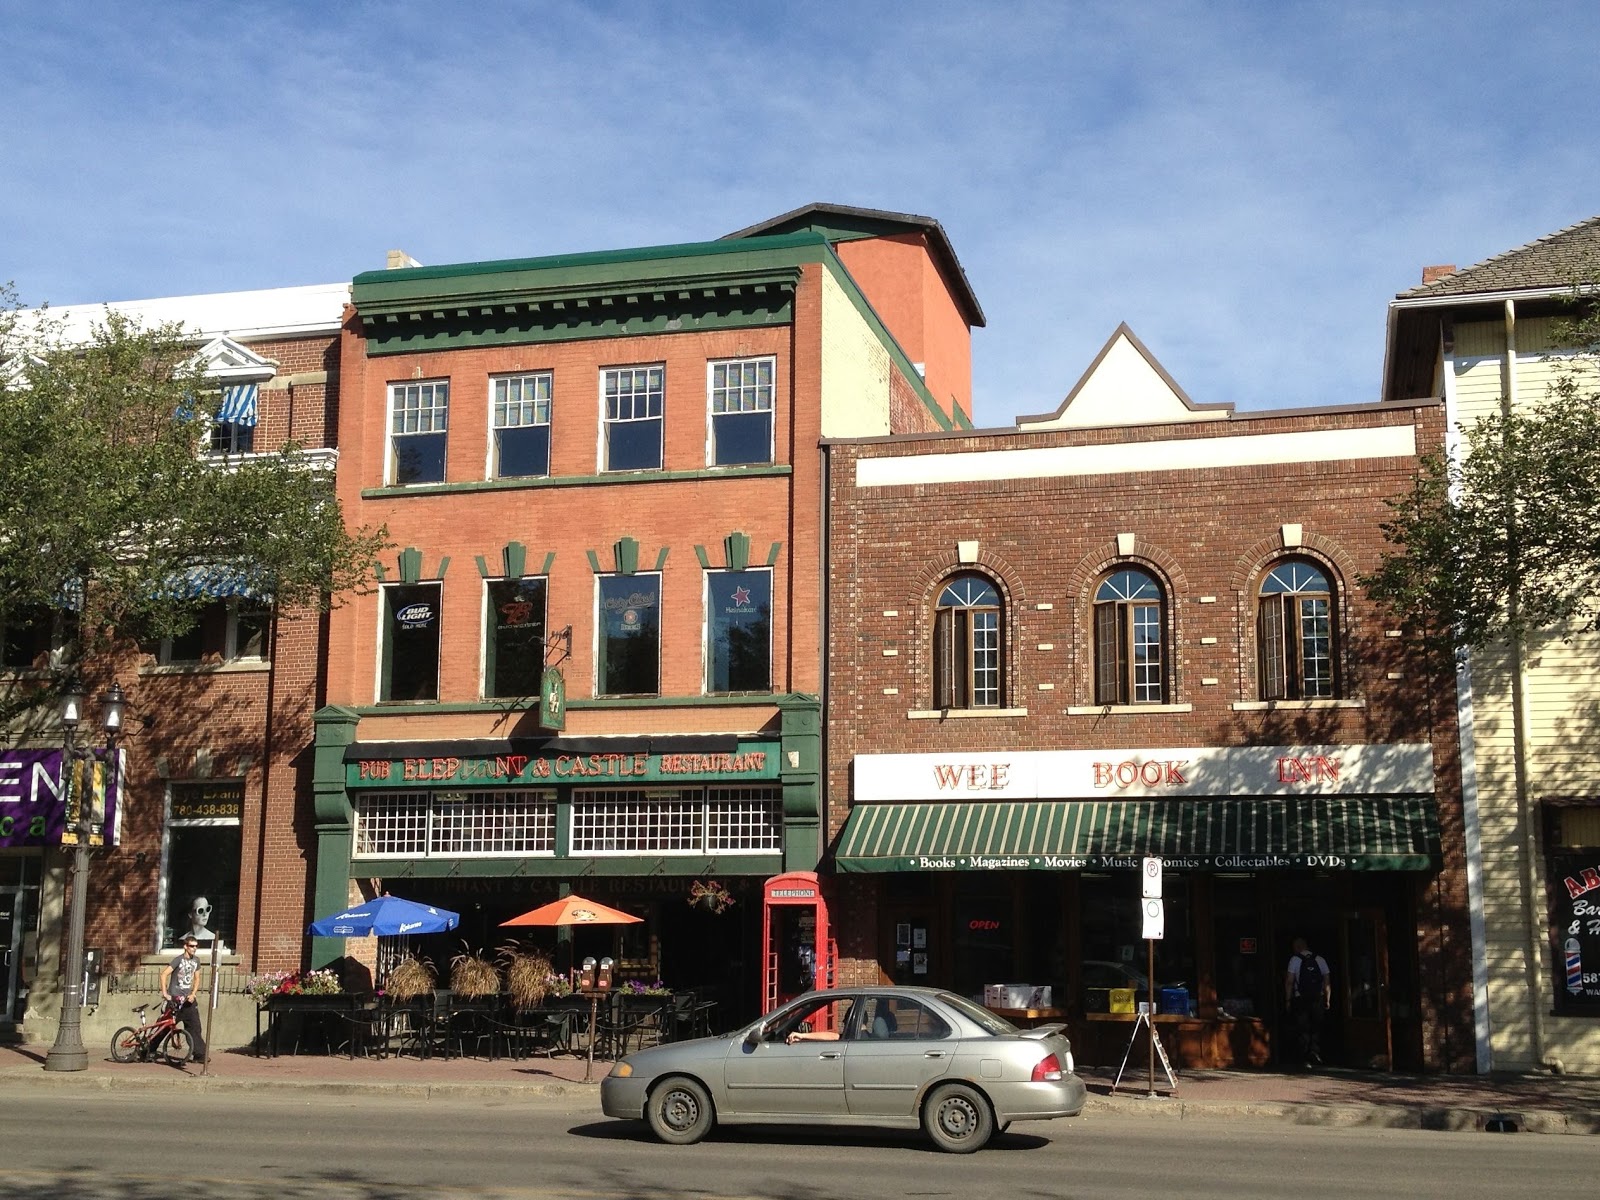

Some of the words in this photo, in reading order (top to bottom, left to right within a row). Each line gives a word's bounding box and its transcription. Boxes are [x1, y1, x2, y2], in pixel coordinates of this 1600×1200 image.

[406, 606, 429, 614] BUD
[401, 612, 433, 620] LIGHT
[359, 761, 392, 779] PUB
[533, 757, 550, 778] &
[554, 753, 649, 777] CASTLE
[659, 752, 765, 775] RESTAURANT
[933, 763, 1010, 789] WEE
[1092, 760, 1188, 788] BOOK
[1276, 756, 1340, 783] INN
[919, 857, 956, 868] Books
[969, 856, 1030, 869] Magazines
[1044, 856, 1087, 868] Movies
[1101, 856, 1138, 868] Music
[1214, 855, 1291, 868] Collectables
[1306, 855, 1347, 867] DVDs
[774, 889, 815, 897] TELEPHONE
[969, 920, 1000, 930] OPEN
[1568, 919, 1581, 934] &
[1583, 972, 1600, 983] 58
